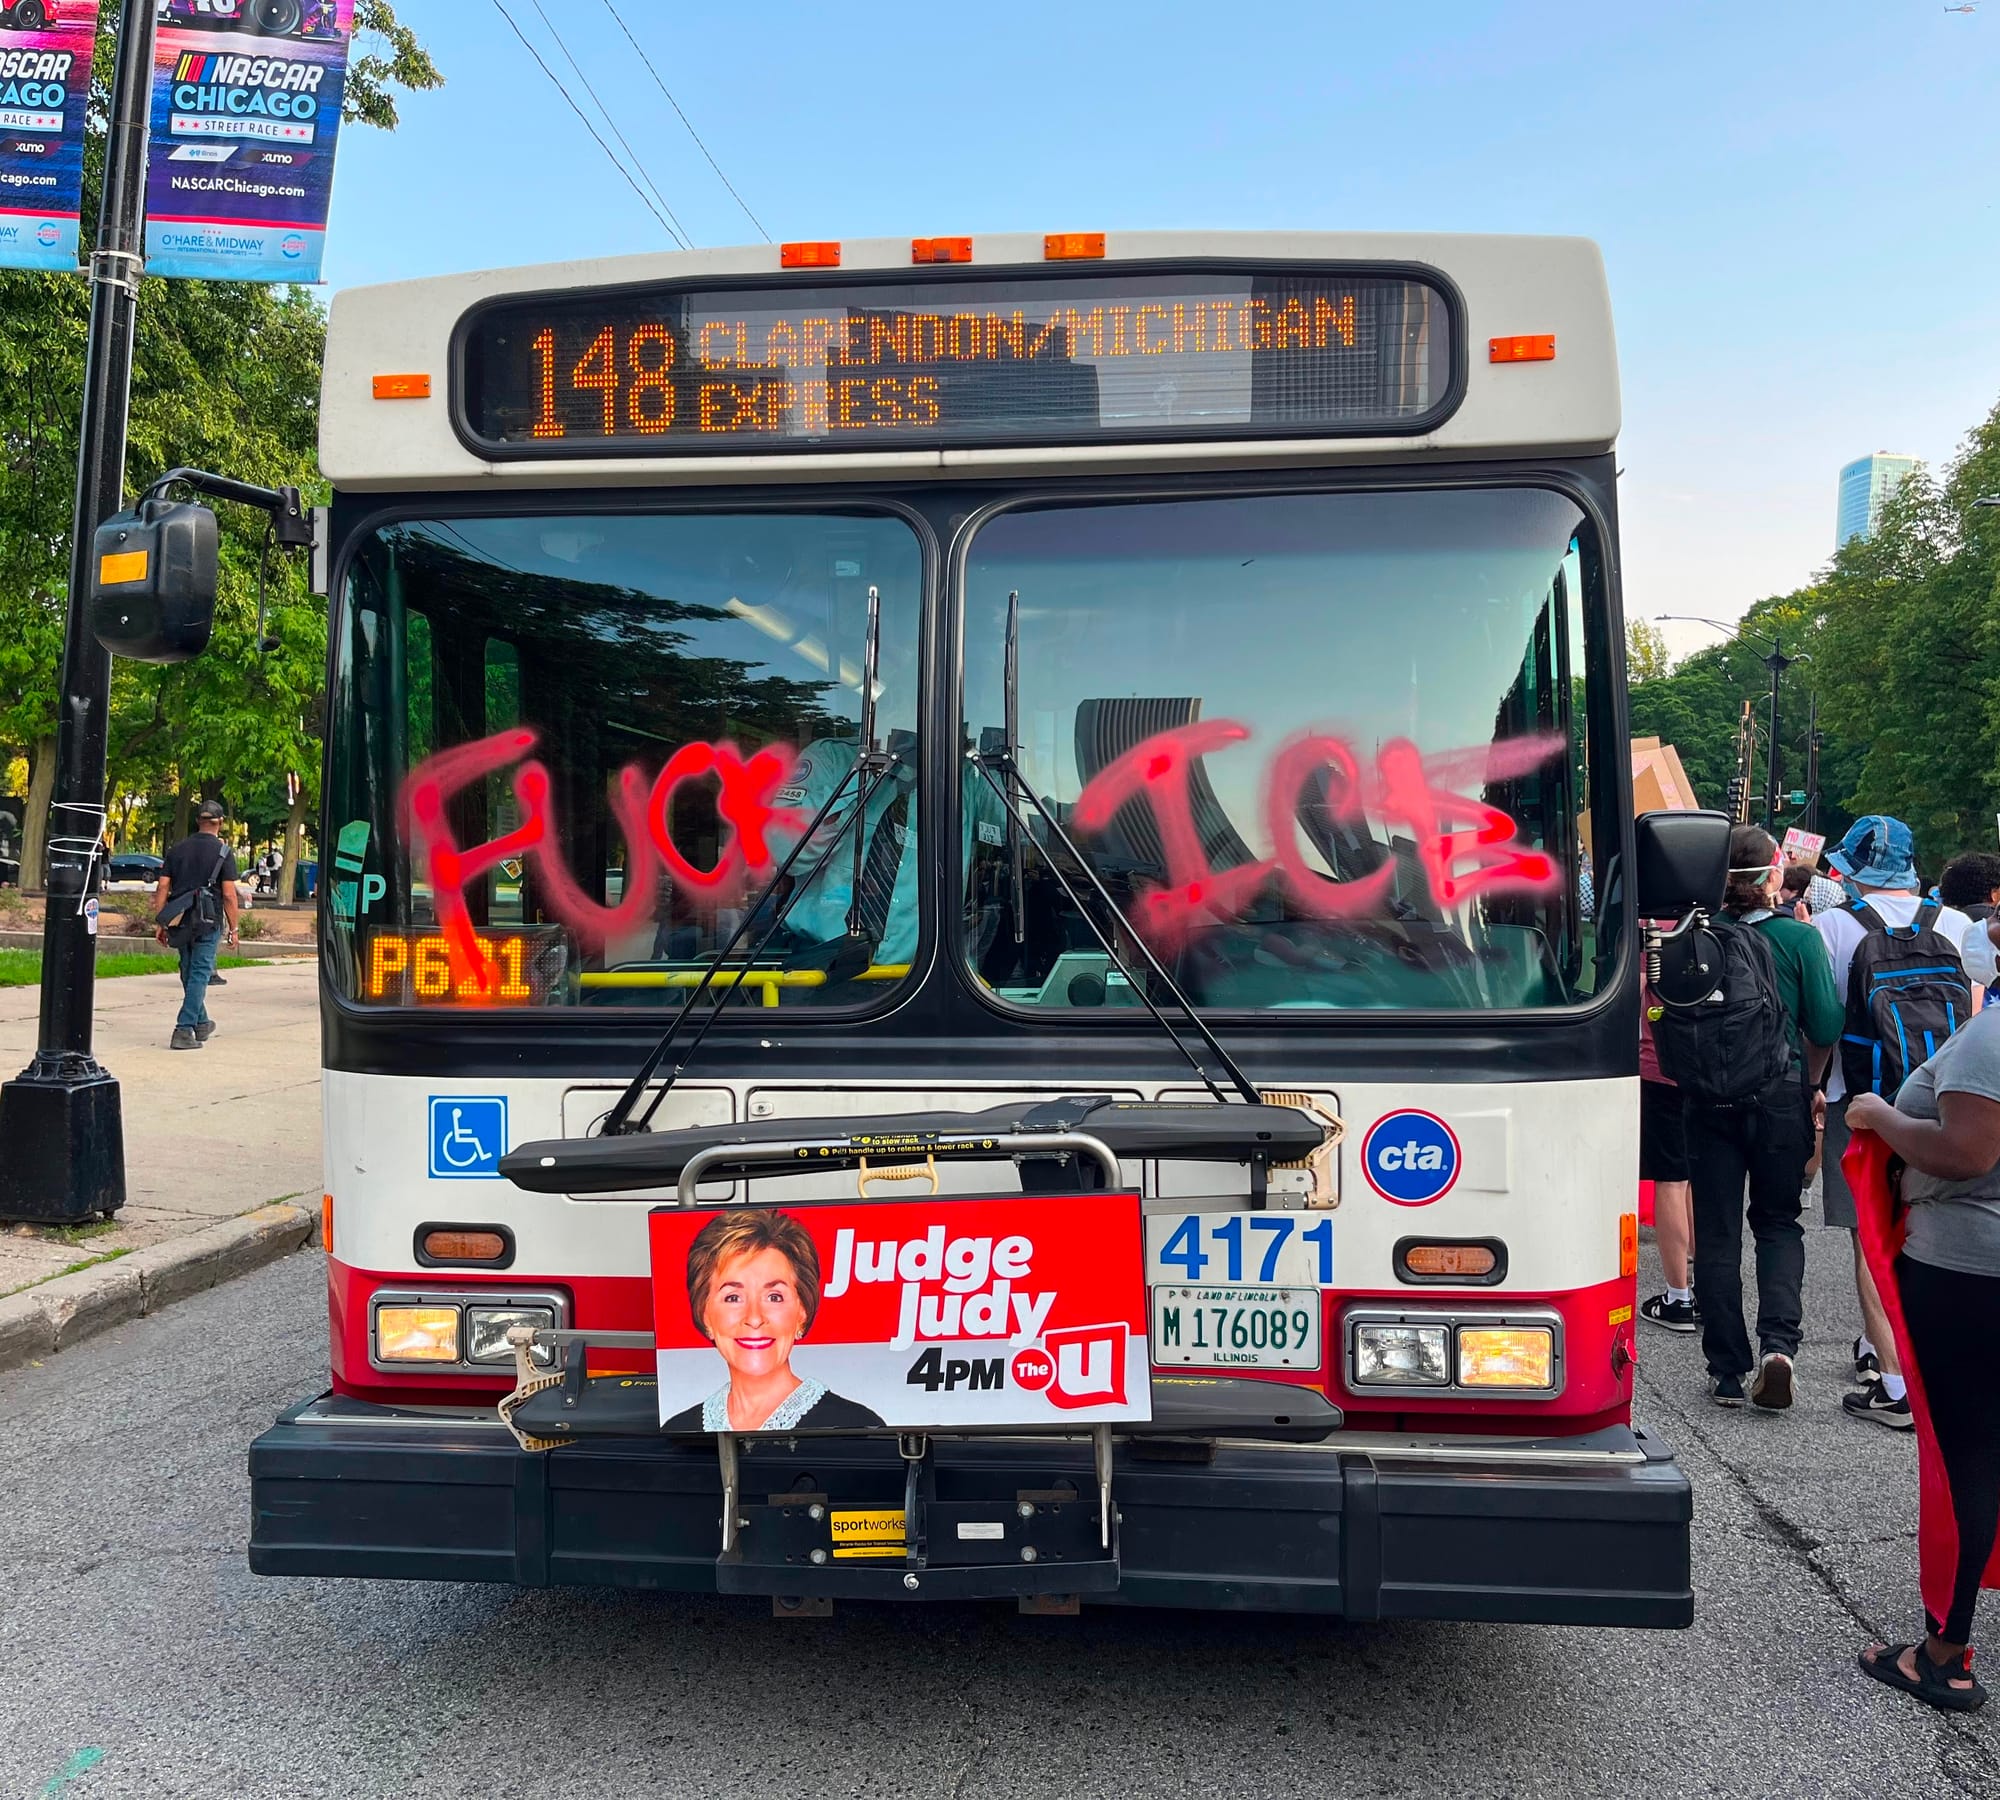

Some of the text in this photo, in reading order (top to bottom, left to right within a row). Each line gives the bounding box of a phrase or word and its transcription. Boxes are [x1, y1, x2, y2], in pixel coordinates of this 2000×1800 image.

[0, 52, 72, 80] SCAR
[211, 56, 325, 92] NASCAR
[0, 80, 66, 108] AGO
[174, 84, 317, 119] CHICAGO
[4, 114, 31, 125] RACE
[204, 120, 279, 136] STREET RACE
[261, 153, 293, 165] xumo
[172, 177, 305, 197] NASCARChicago.com
[162, 234, 204, 247] O'HARE
[215, 237, 265, 250] MIDWAY
[699, 296, 1355, 370] CLARENDON/MICHIGAN
[532, 323, 675, 438] 148
[699, 376, 940, 432] EXPRESS
[400, 717, 1566, 1006] FUCK ICE
[823, 1225, 1034, 1298] Judge
[1159, 1215, 1333, 1284] 4171
[1197, 1291, 1222, 1301] LAND
[888, 1279, 1058, 1352] Judy
[1163, 1306, 1310, 1350] M 176089
[906, 1346, 1004, 1391] 4PM
[1017, 1360, 1049, 1377] The
[1213, 1353, 1258, 1363] ILLINOIS
[833, 1517, 906, 1534] sportworks
